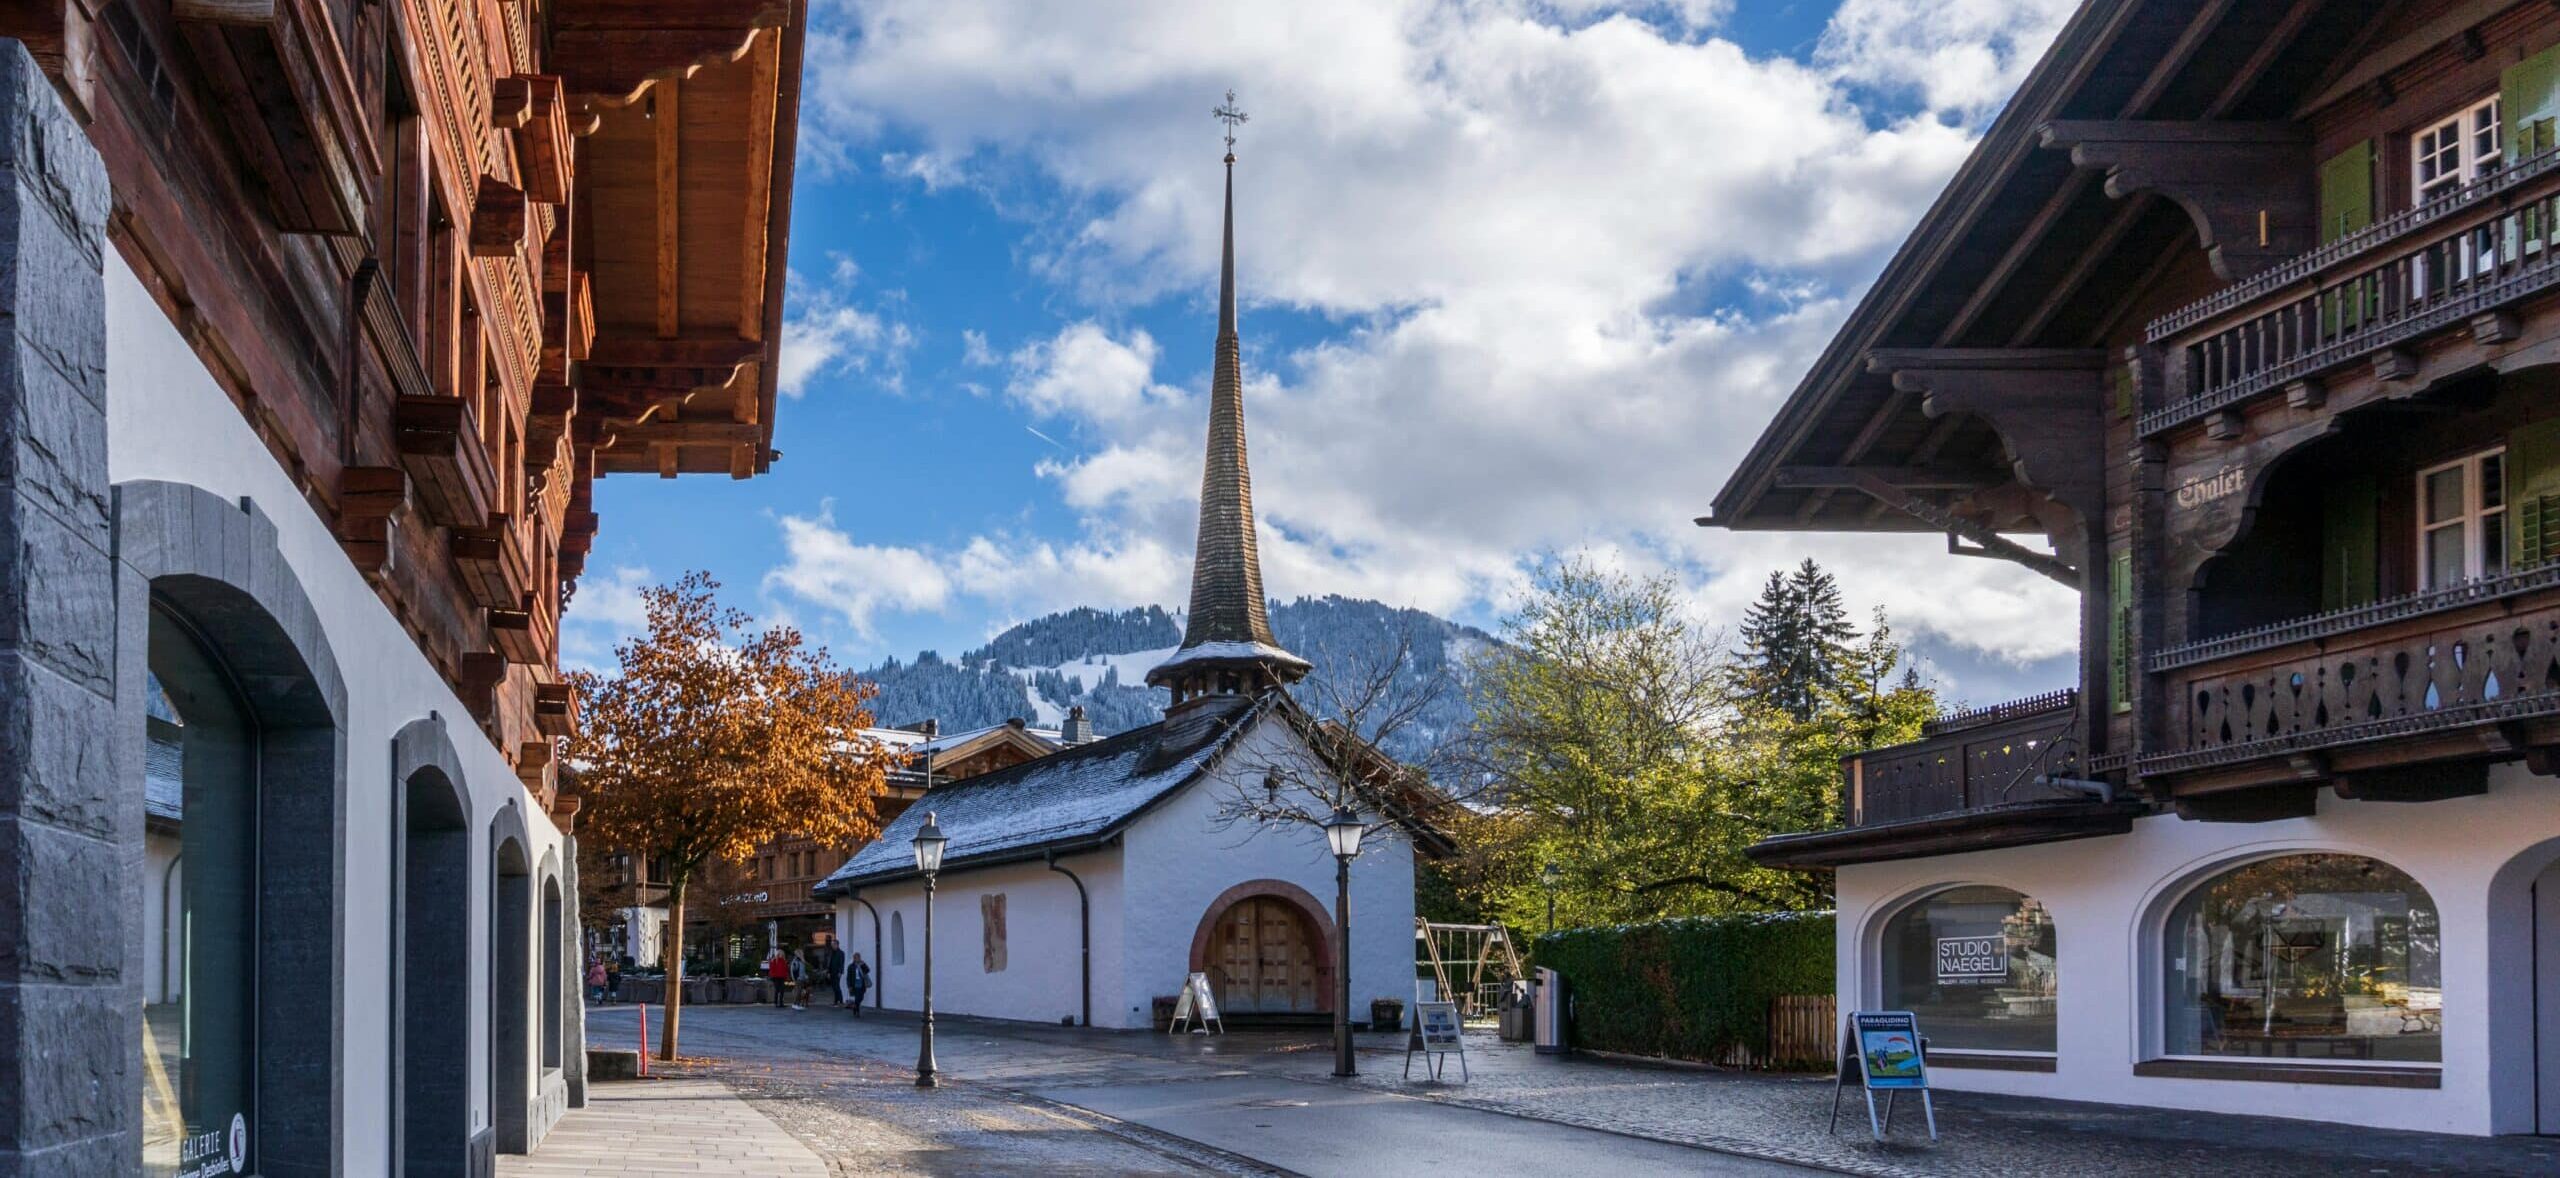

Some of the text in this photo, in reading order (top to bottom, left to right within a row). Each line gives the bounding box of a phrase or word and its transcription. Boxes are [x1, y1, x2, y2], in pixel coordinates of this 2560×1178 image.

[1940, 941, 1991, 957] STUDIO
[1941, 956, 2003, 972] NAEGELI
[183, 1130, 220, 1162] GALERIE
